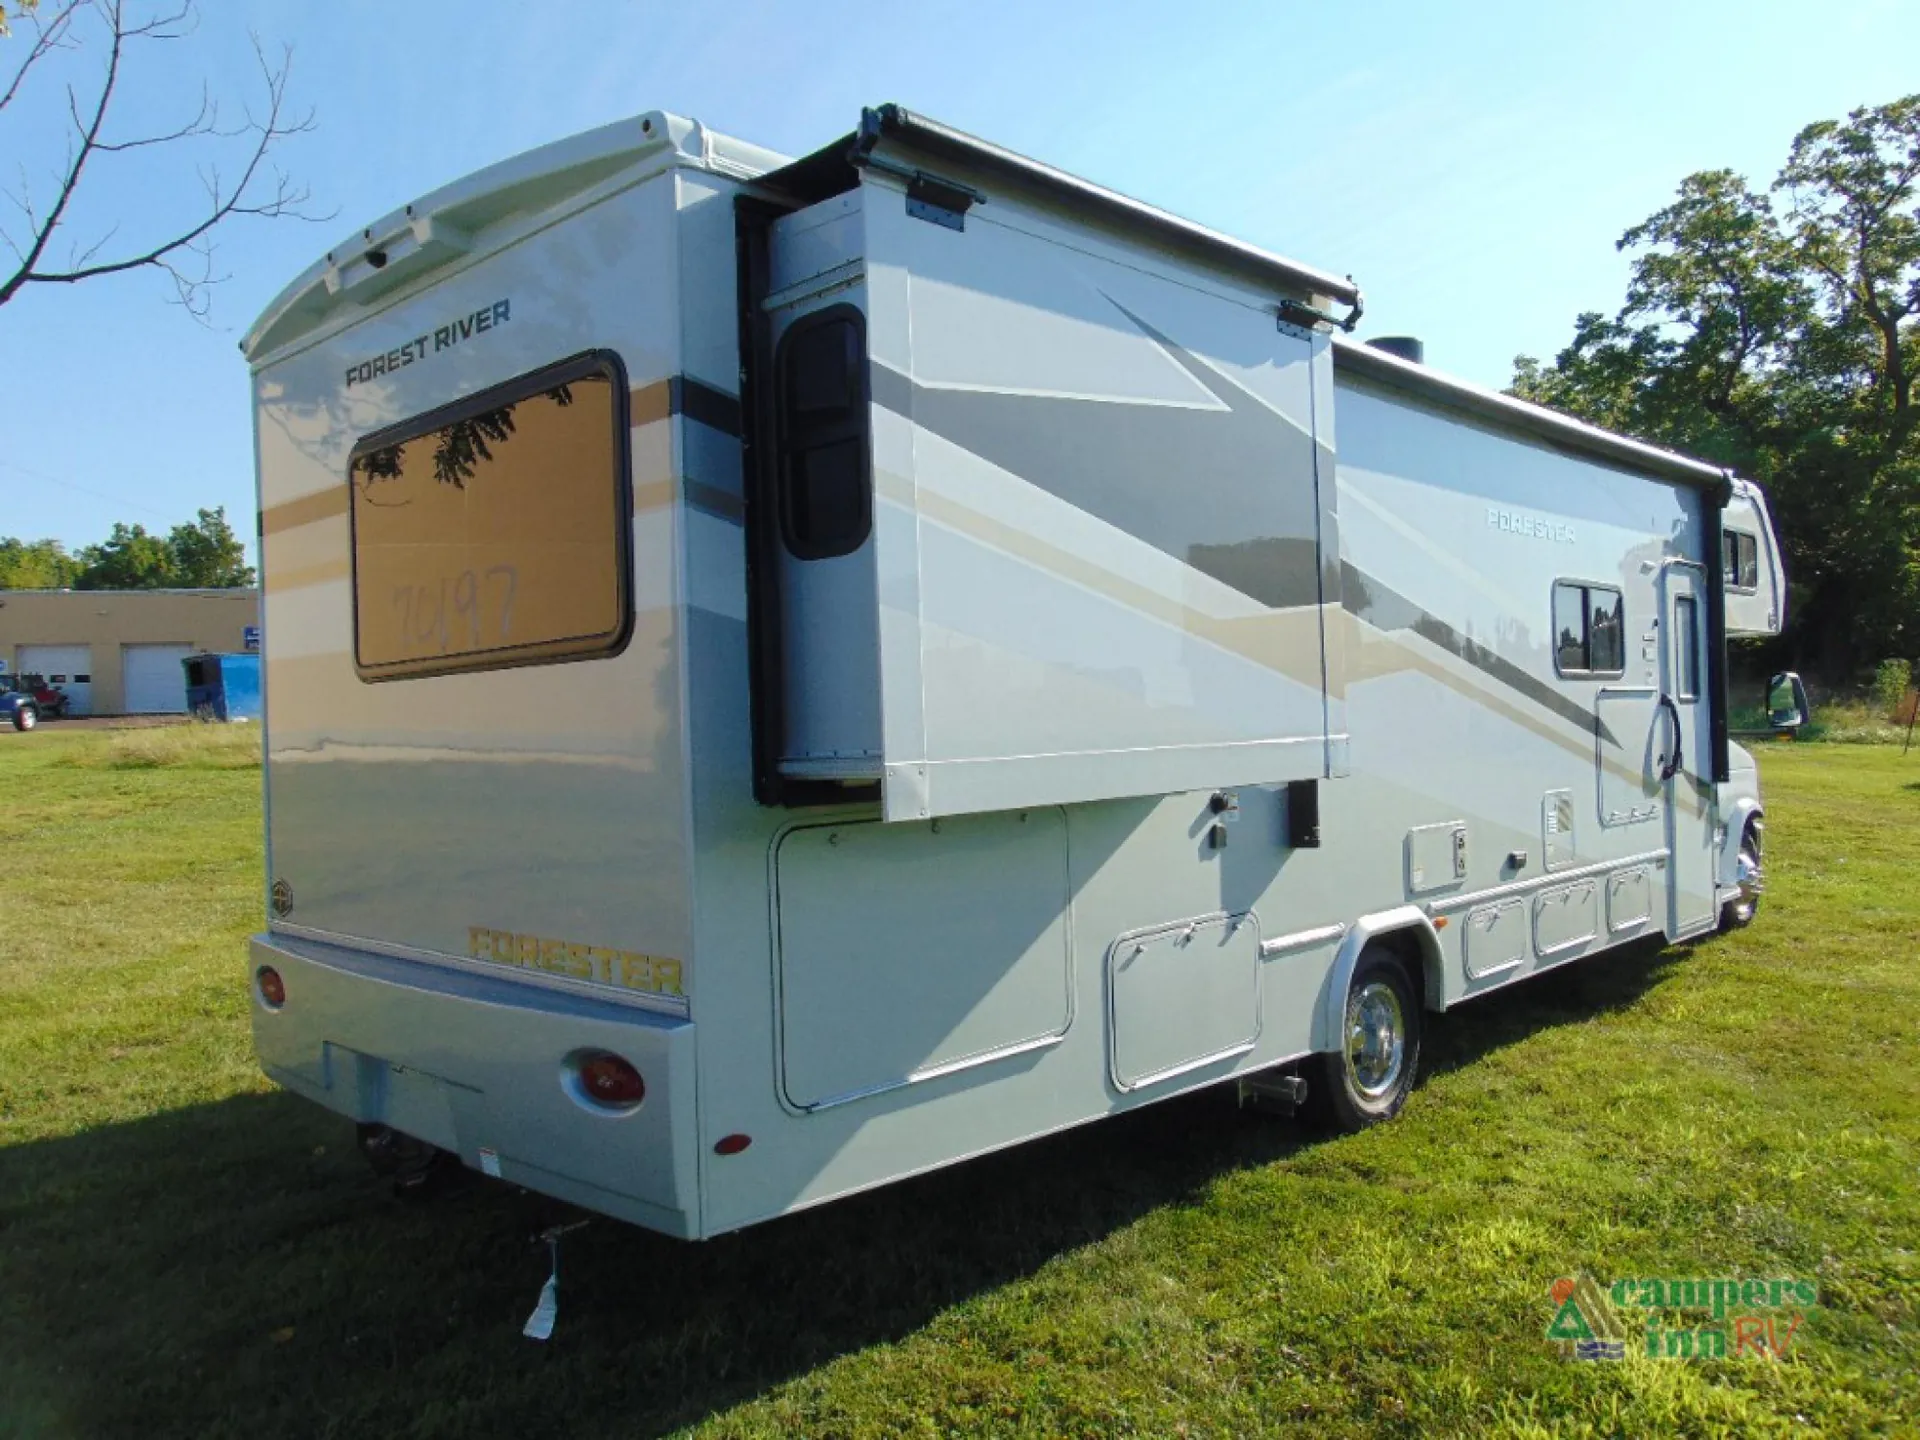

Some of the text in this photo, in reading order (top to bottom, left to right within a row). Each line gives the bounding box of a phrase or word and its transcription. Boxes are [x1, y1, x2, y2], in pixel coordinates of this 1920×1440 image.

[346, 298, 511, 388] FOREST RIVER
[1485, 508, 1575, 544] FORESTER
[468, 927, 684, 997] FORESTER
